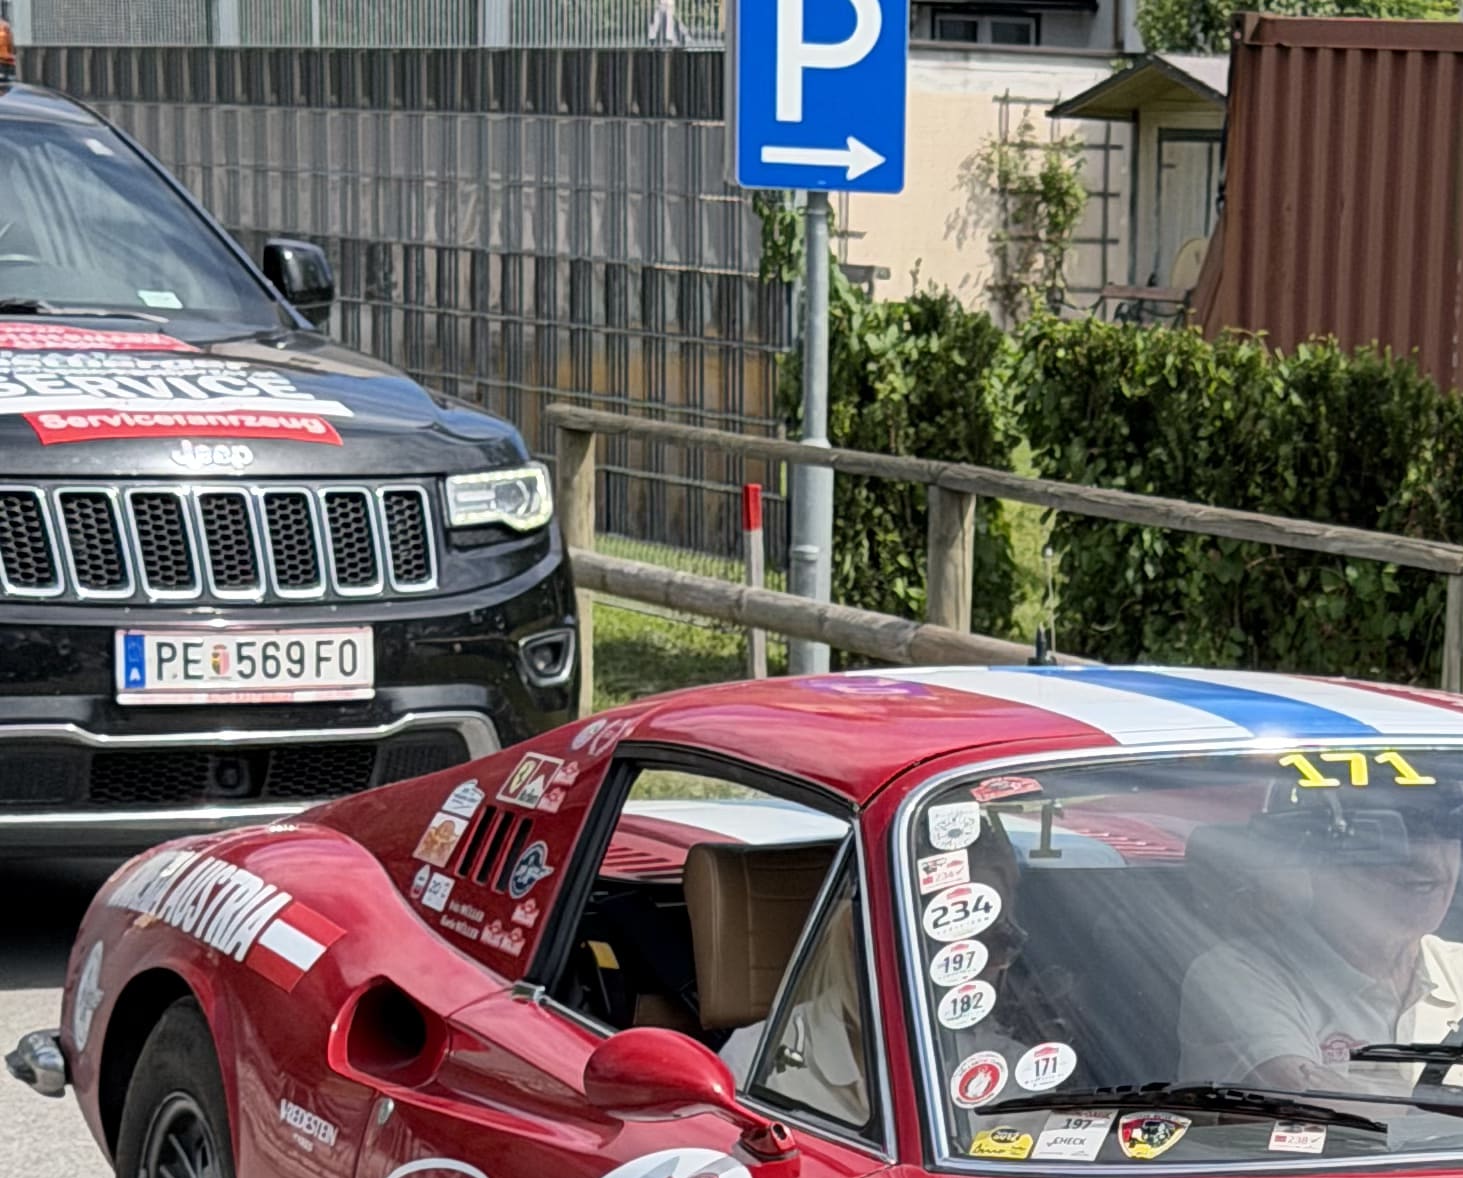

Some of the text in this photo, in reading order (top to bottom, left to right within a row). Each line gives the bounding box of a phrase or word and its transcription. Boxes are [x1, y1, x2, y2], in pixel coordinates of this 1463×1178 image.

[776, 0, 882, 121] P
[0, 370, 315, 401] SERVICE
[171, 440, 254, 469] Jeep
[156, 641, 204, 680] PE
[236, 640, 304, 679] 569
[1279, 751, 1437, 787] 171
[156, 856, 293, 962] AUSTRIA
[931, 894, 993, 929] 234
[943, 951, 976, 974] 197
[951, 992, 984, 1016] 182
[1034, 1056, 1058, 1078] 171
[1063, 1117, 1093, 1130] 197
